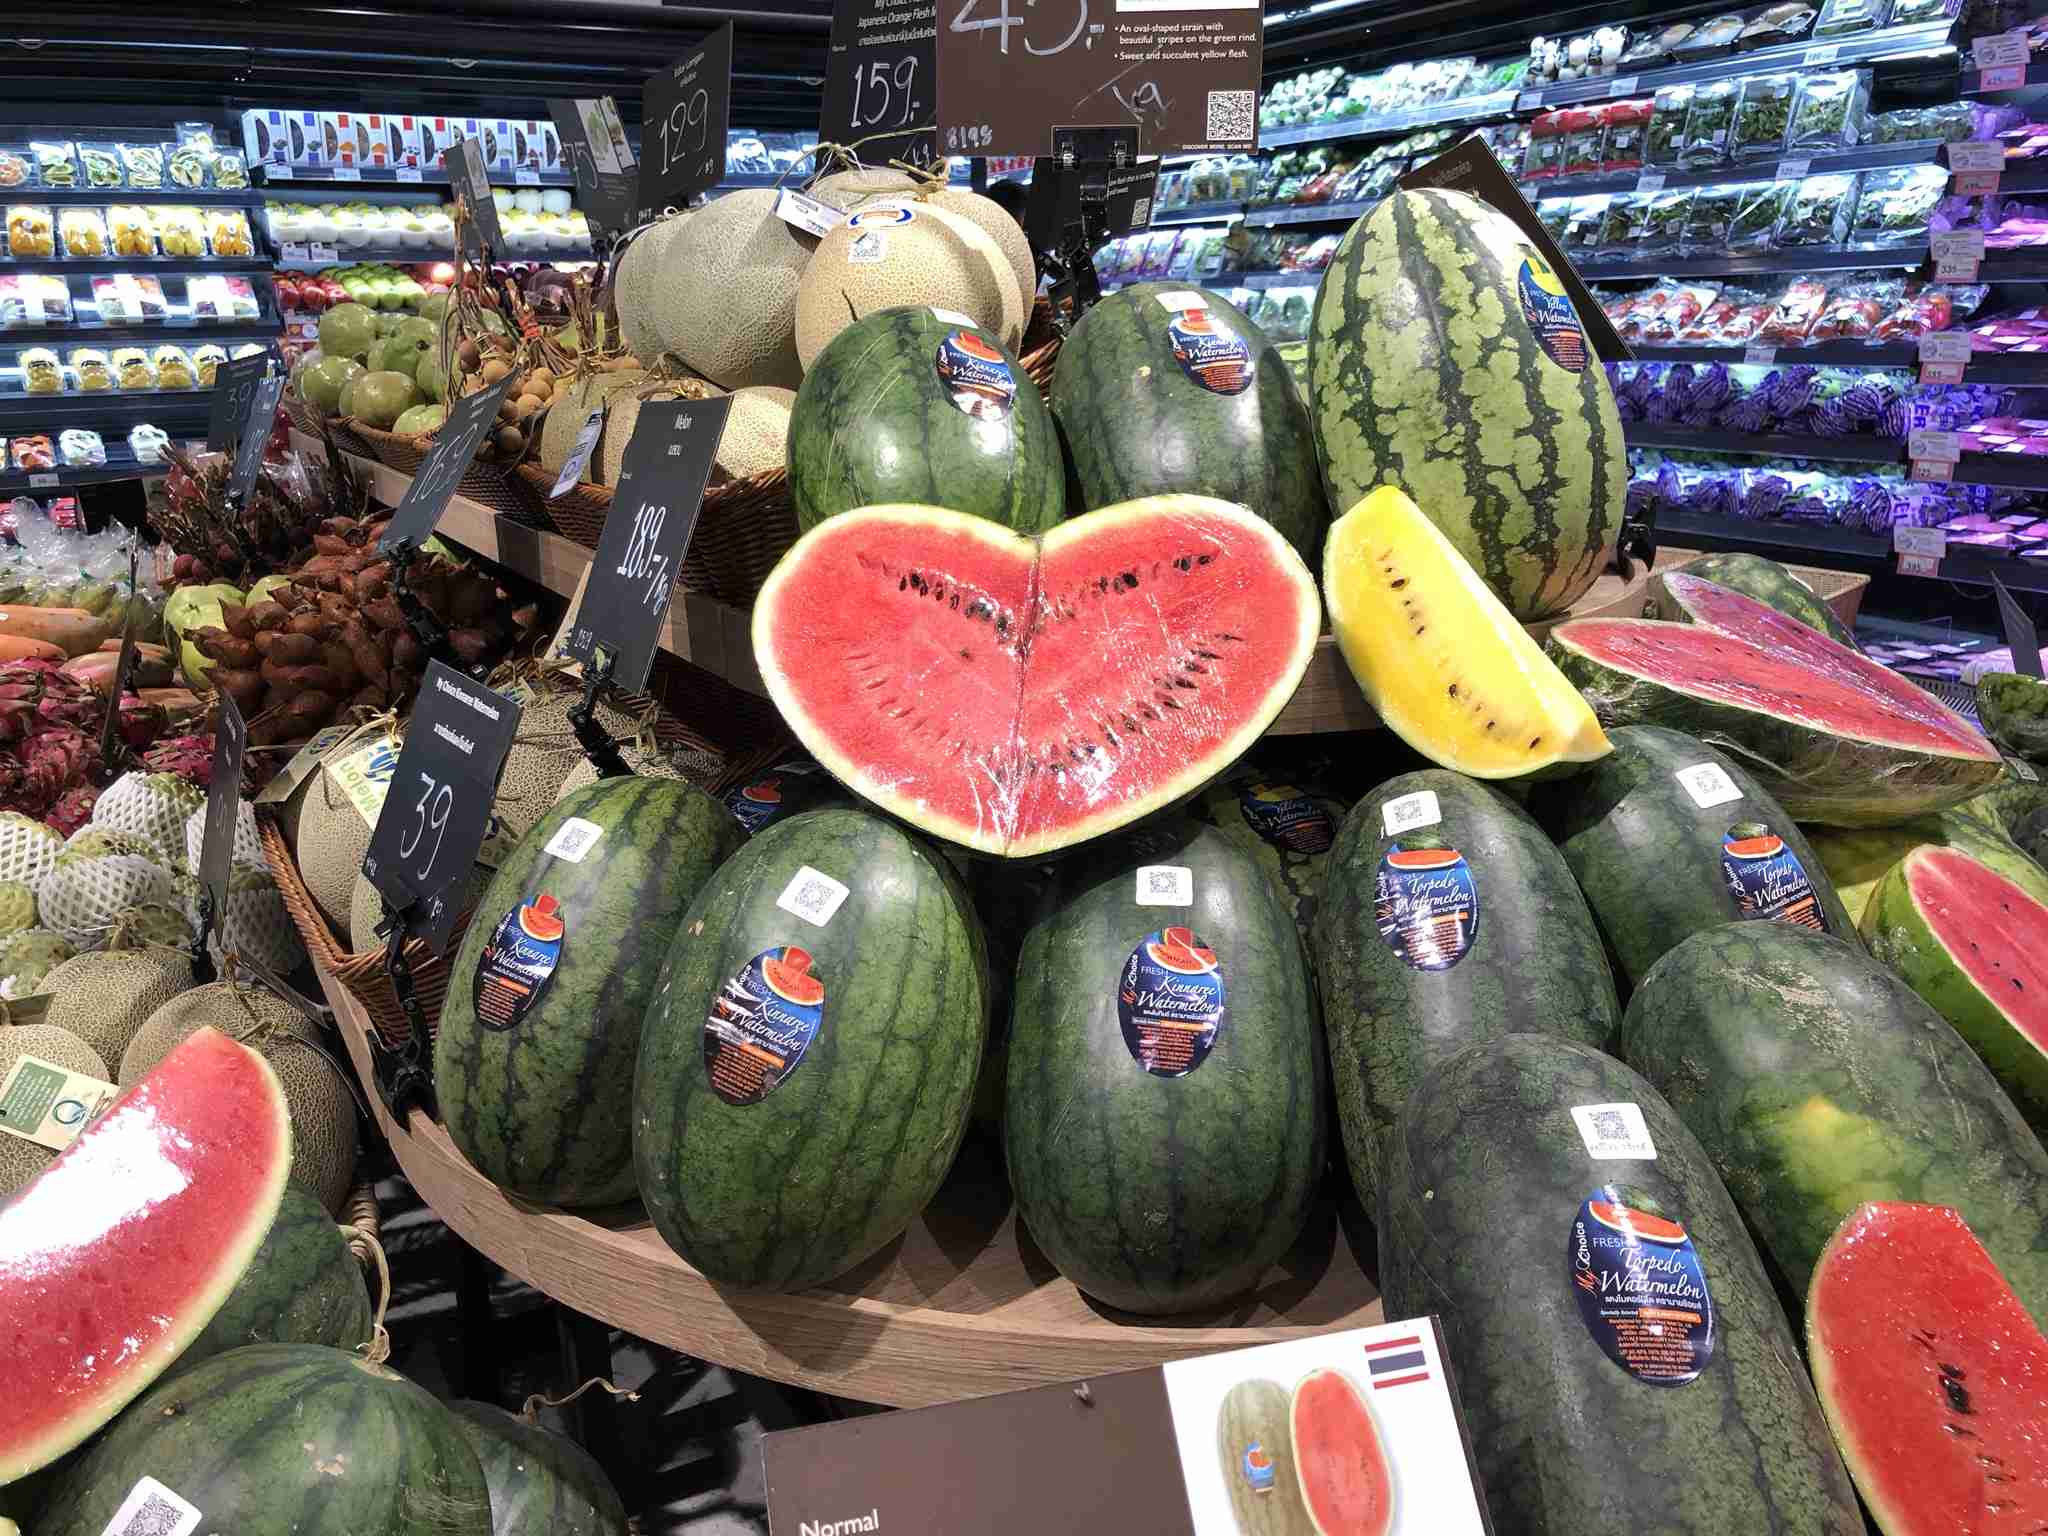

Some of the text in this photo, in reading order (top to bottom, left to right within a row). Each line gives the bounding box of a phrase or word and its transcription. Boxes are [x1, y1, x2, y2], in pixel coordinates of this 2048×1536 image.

[1119, 22, 1224, 34] An oval-shaped strain with
[1119, 35, 1153, 44] beautiful
[1158, 35, 1184, 46] stripes
[1199, 33, 1211, 43] the
[1213, 35, 1237, 45] green
[1119, 51, 1144, 61] Sweet
[1146, 51, 1160, 60] and
[1162, 50, 1199, 60] succulent
[1200, 49, 1226, 61] yellow
[1618, 1247, 1686, 1280] Torpedo
[1601, 1269, 1705, 1300] Watermelon
[800, 1507, 880, 1536] Normal
